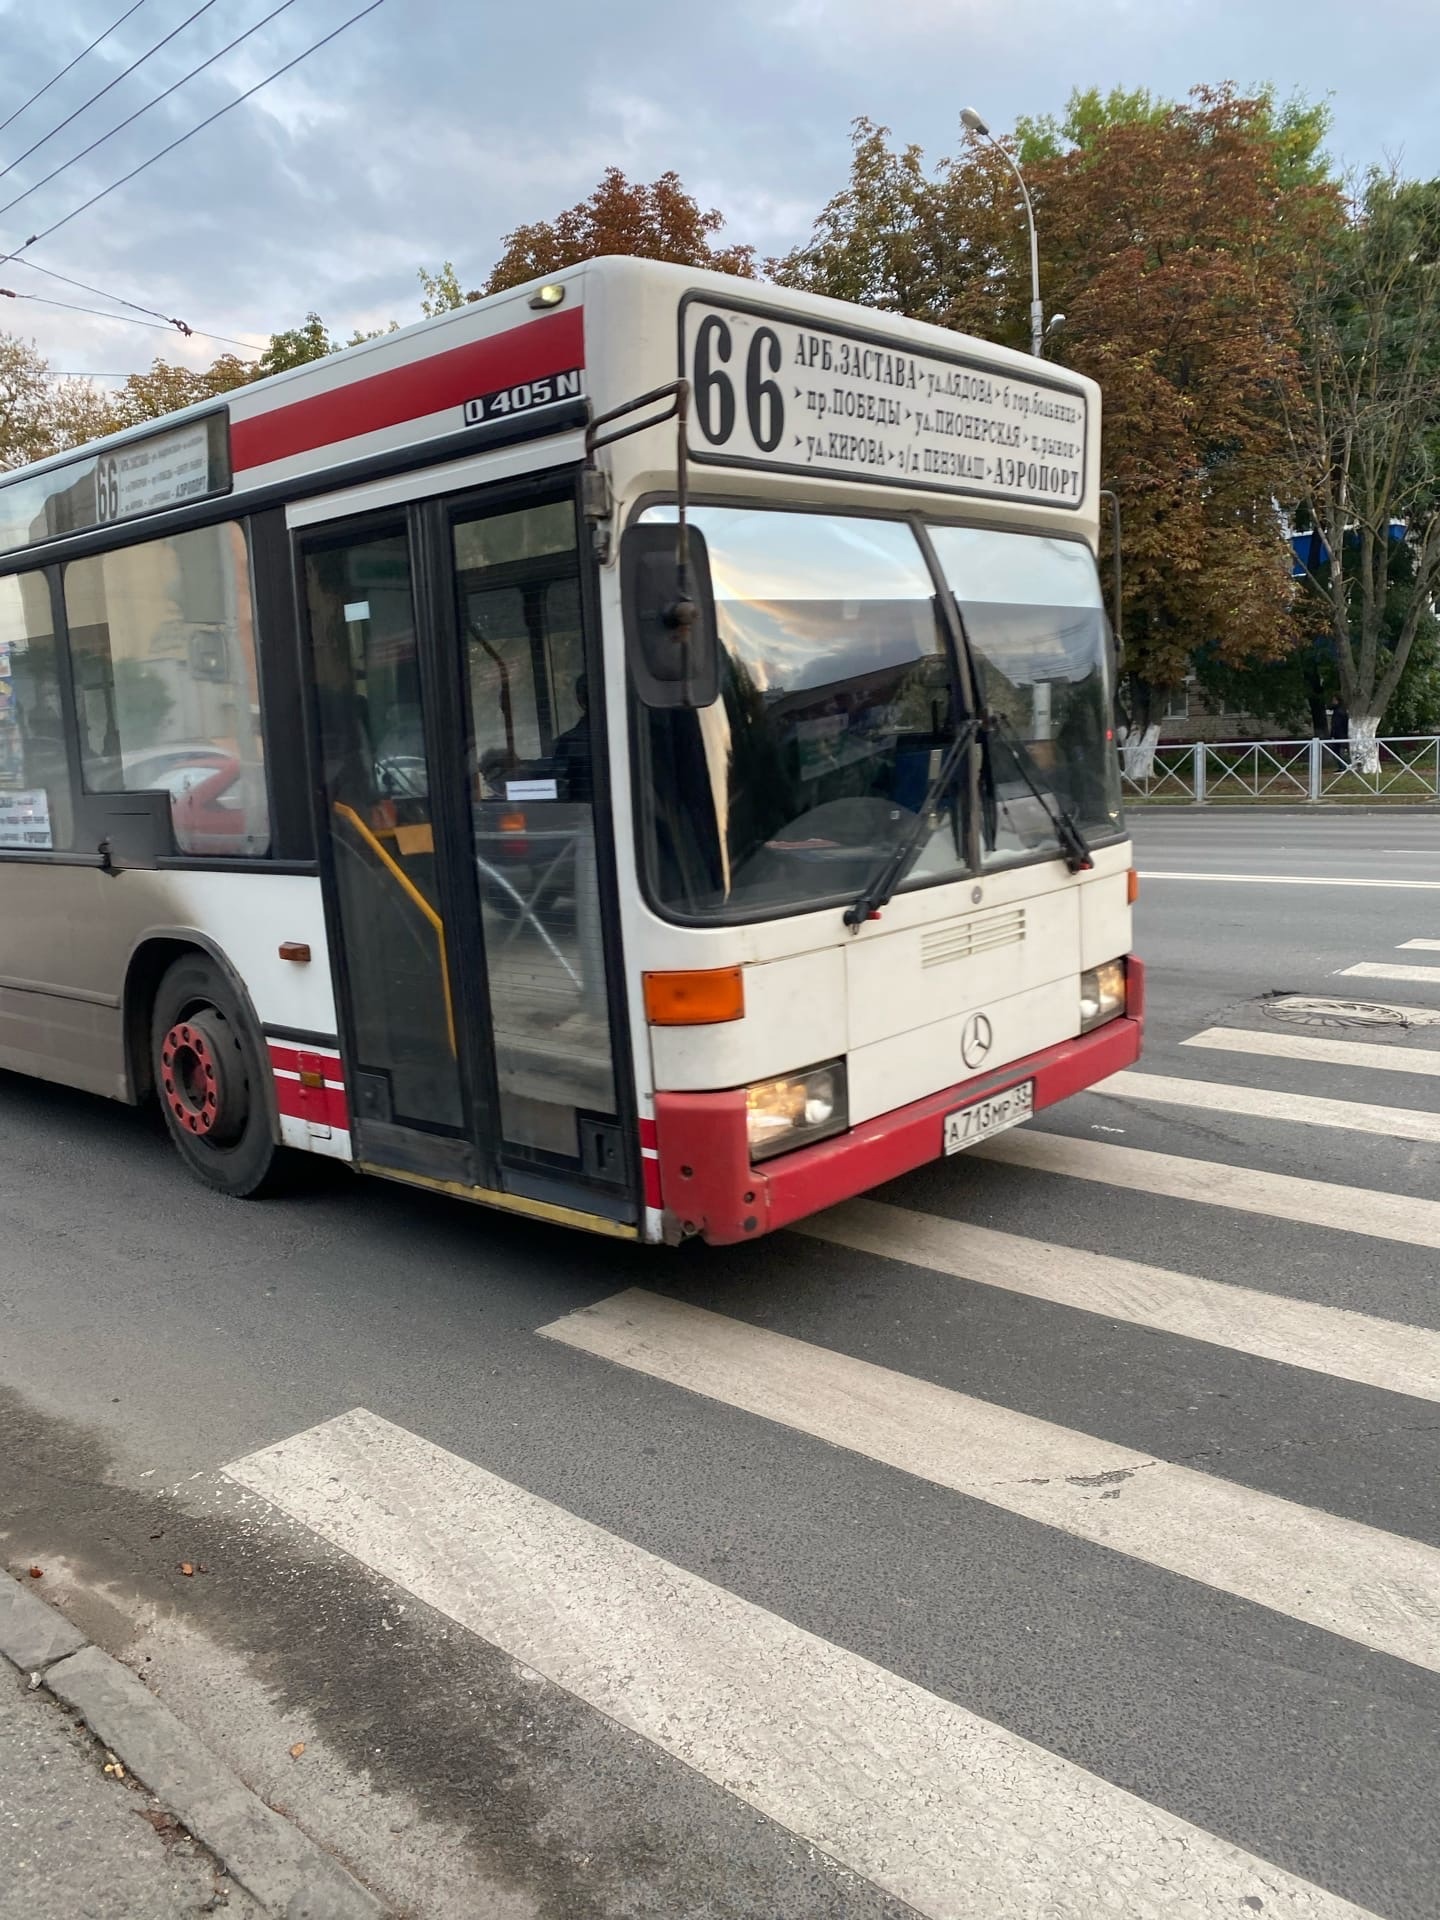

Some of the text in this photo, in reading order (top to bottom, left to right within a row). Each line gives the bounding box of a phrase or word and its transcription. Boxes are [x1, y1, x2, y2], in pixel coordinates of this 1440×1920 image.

[490, 378, 552, 413] 405
[557, 370, 579, 397] N
[694, 313, 784, 453] 66
[795, 333, 916, 389] АРБ.ЗАСТАВА
[928, 371, 992, 404] ул.ЛЯДОВА
[807, 388, 901, 427] пр.ПОБЕДЫ
[915, 409, 1020, 448] ул.ПИОНЕРСКАЯ
[97, 458, 118, 522] 66
[806, 432, 885, 466] ул.КИРОВА
[924, 448, 985, 480] ПЕНЗМАШ
[994, 457, 1079, 496] АЭРОПОРТ
